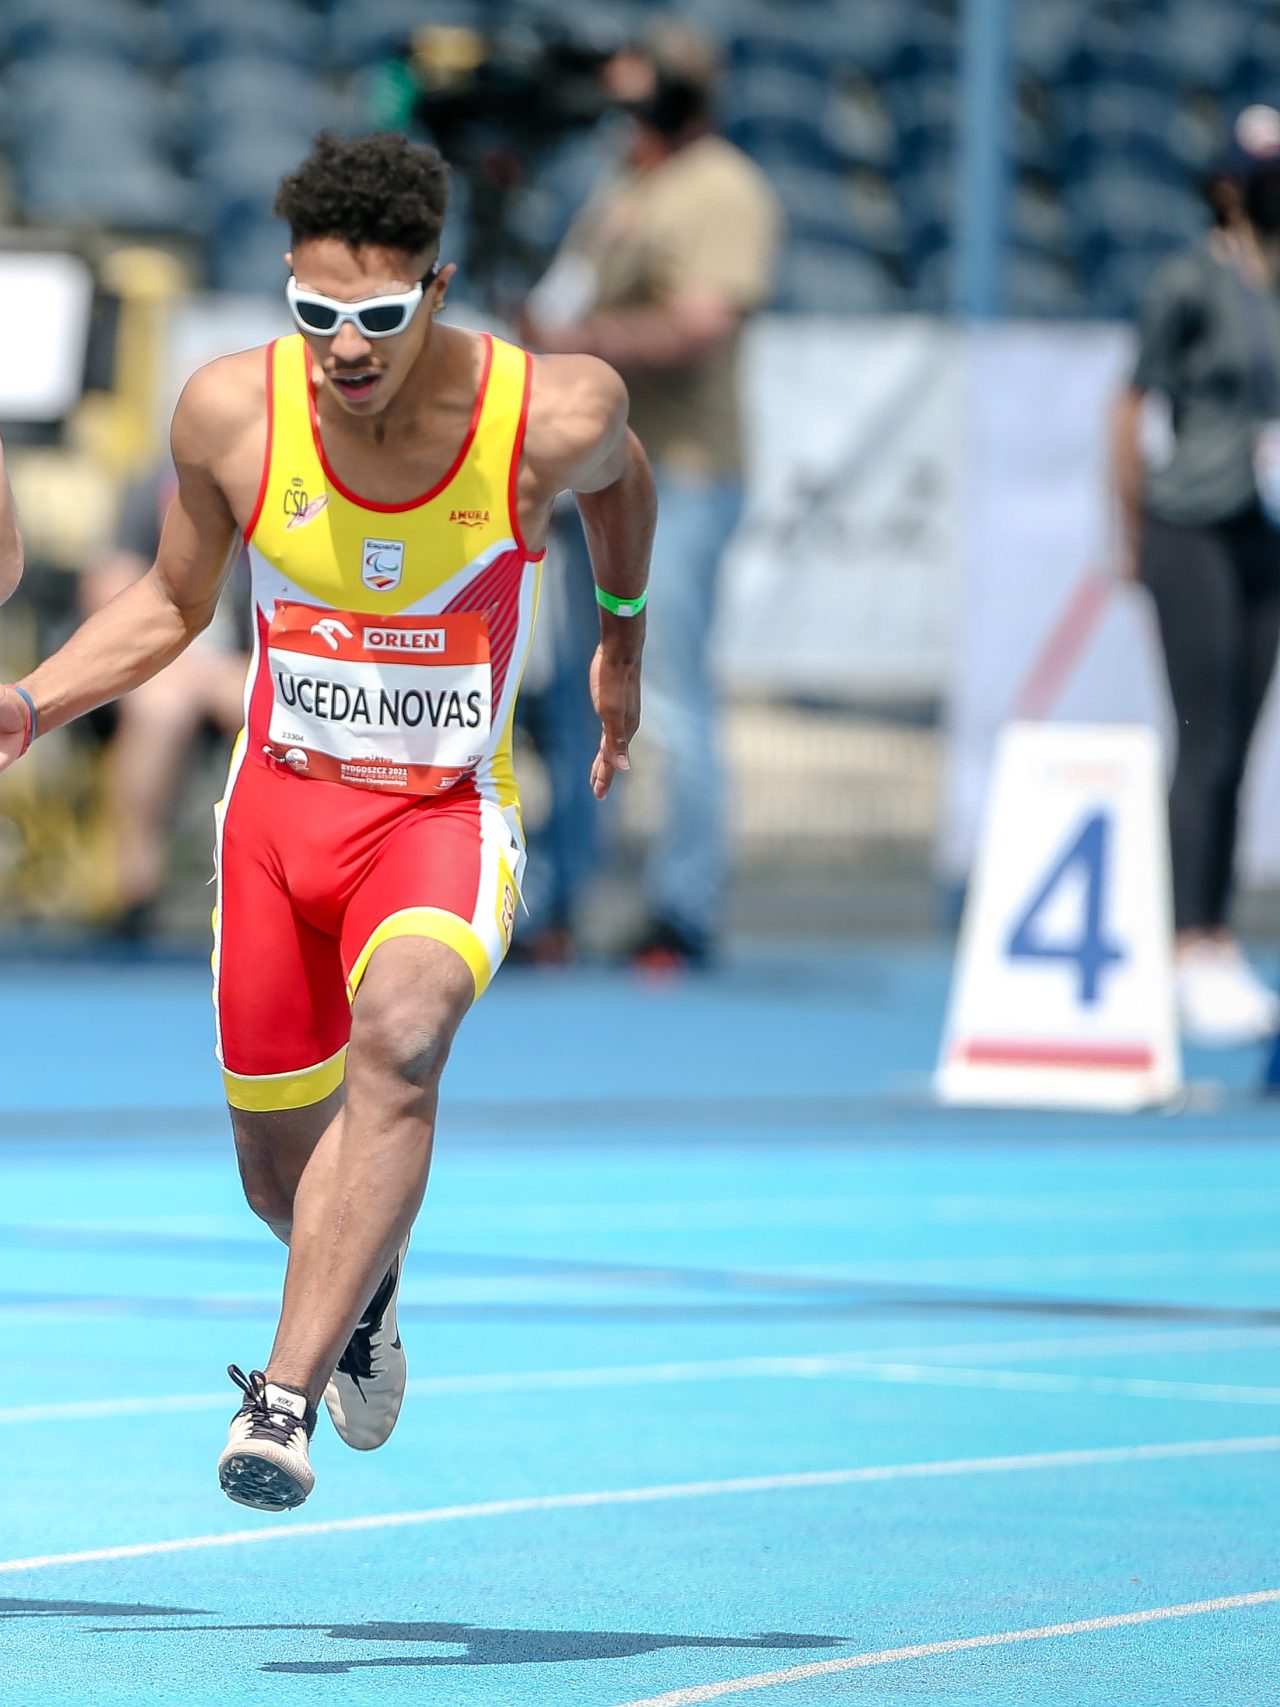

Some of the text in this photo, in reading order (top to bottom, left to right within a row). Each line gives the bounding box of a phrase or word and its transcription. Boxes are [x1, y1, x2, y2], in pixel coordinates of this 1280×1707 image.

[283, 489, 308, 516] CSD
[449, 510, 490, 521] AMURA
[368, 631, 439, 648] ORLEN
[278, 672, 482, 728] UCEDA NOVAS
[281, 731, 304, 741] 23304
[341, 764, 407, 775] BYDGOSZCZ 2021
[1007, 812, 1124, 1006] 4
[276, 1396, 295, 1407] NIKE
